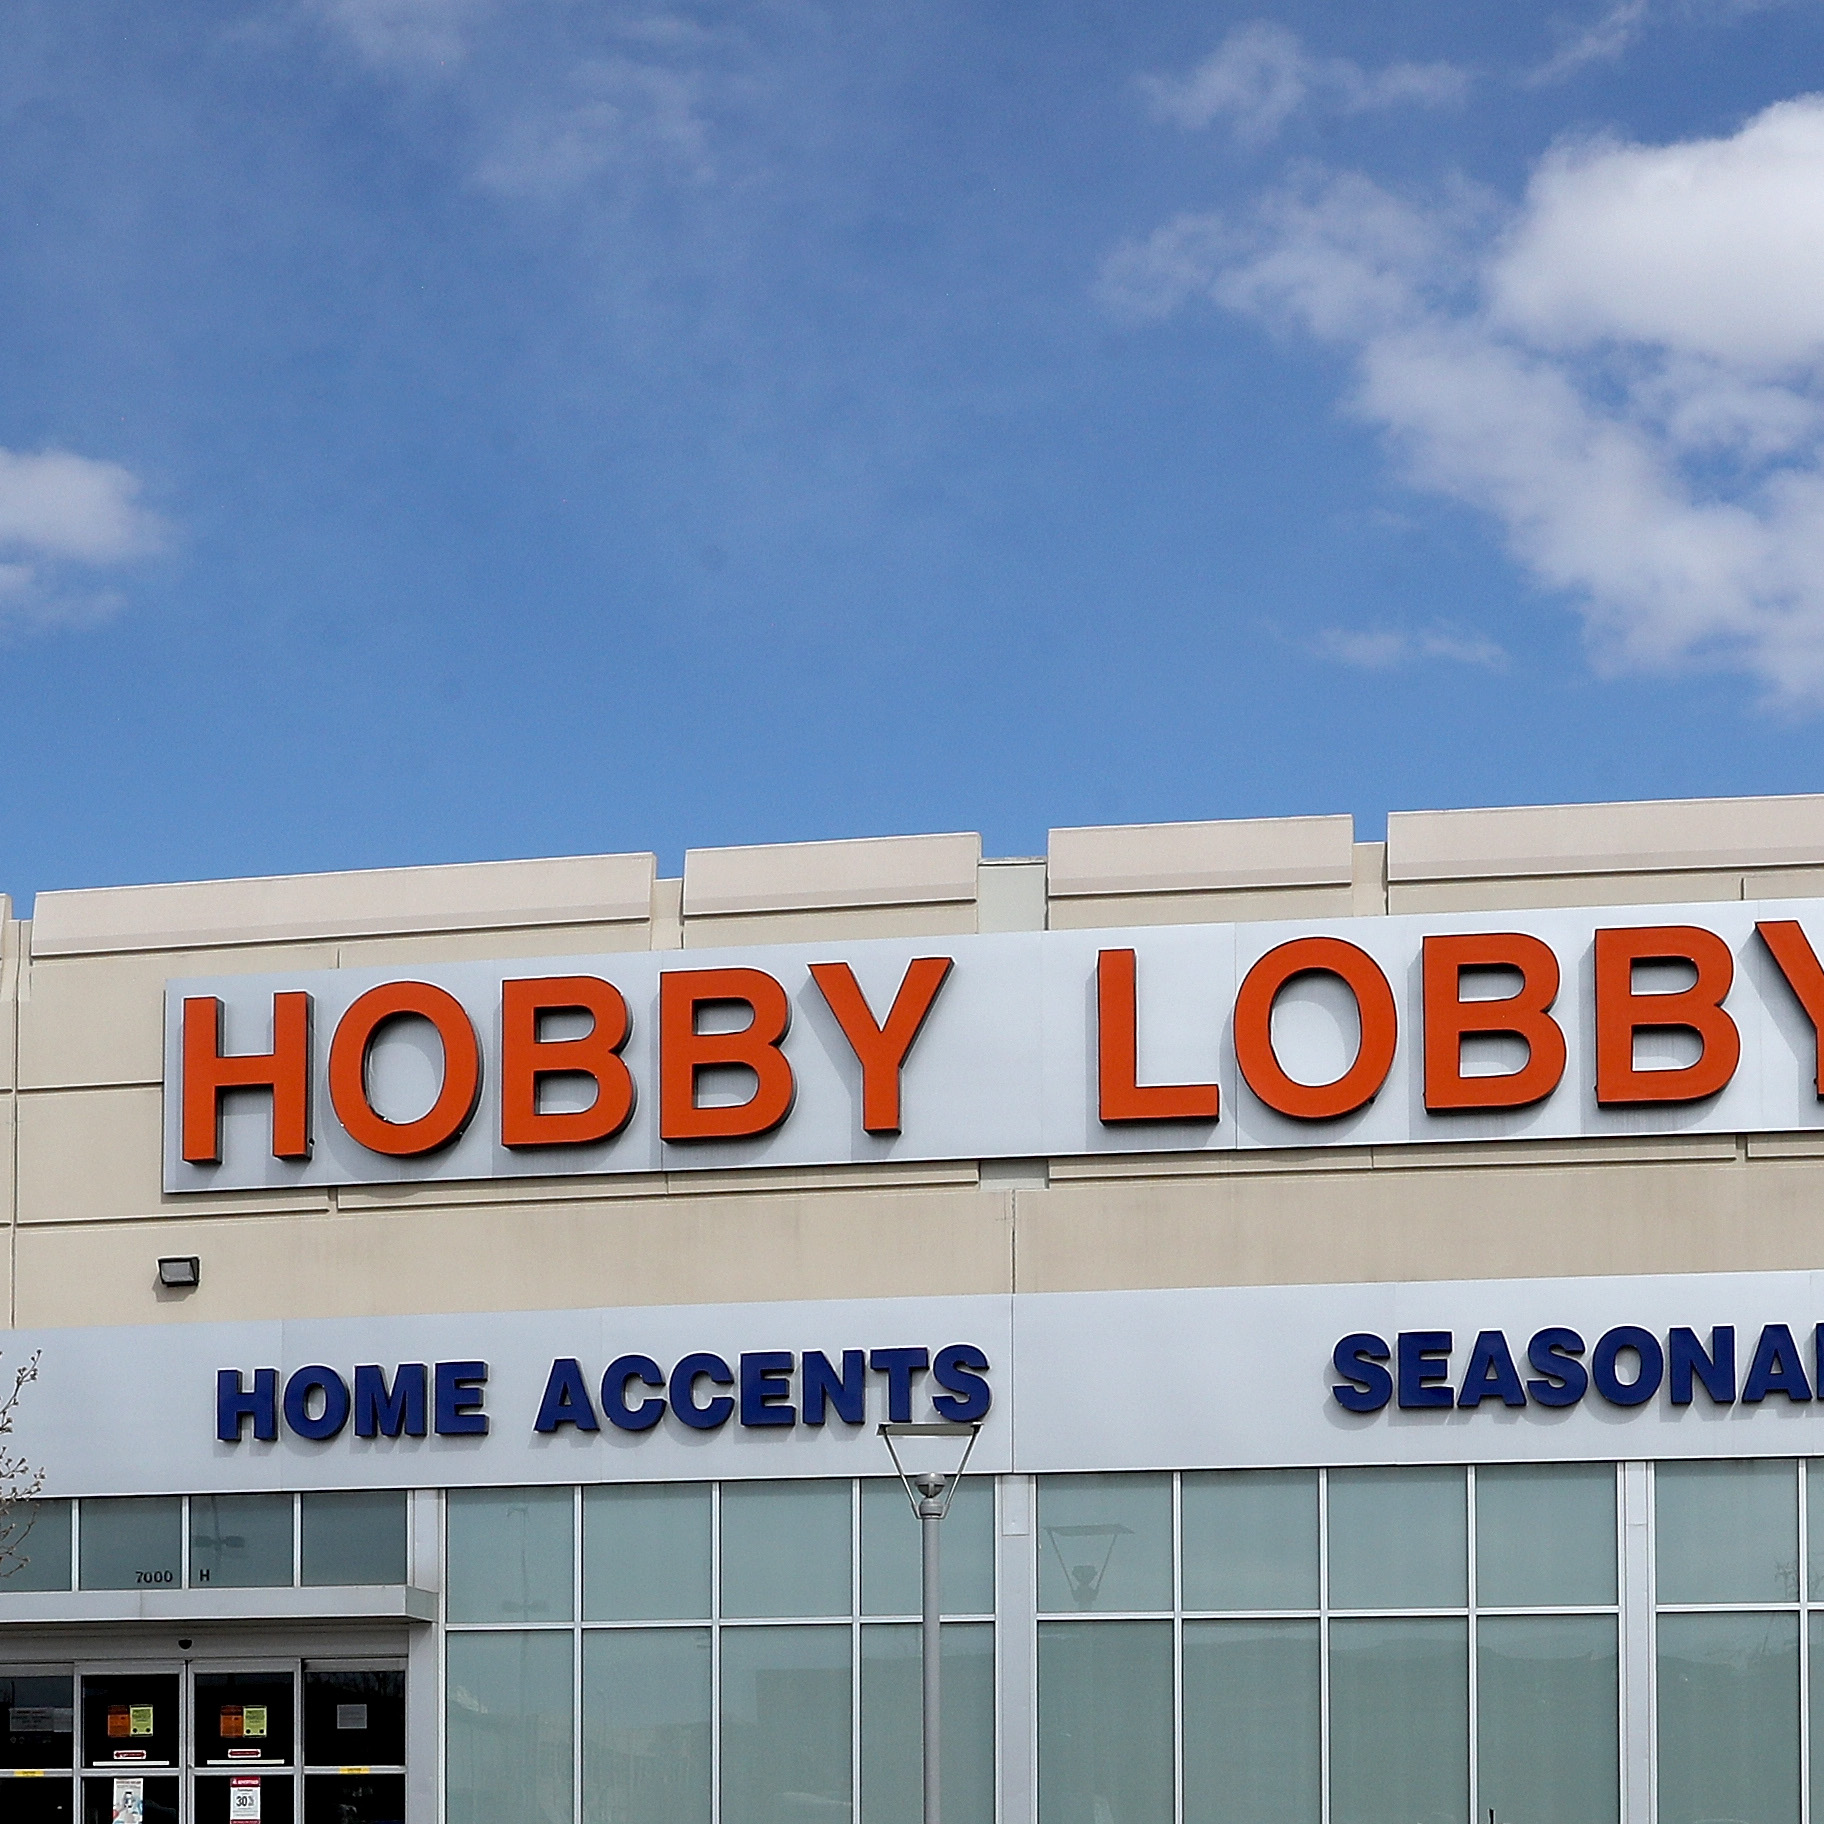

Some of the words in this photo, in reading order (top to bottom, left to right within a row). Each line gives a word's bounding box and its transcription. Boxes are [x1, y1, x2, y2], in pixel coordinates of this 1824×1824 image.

[181, 956, 956, 1166] HOBBY
[215, 1359, 490, 1442] HOME
[533, 1343, 992, 1434] ACCENTS
[135, 1569, 173, 1584] 7000
[199, 1568, 210, 1582] H
[236, 1795, 248, 1807] 30
